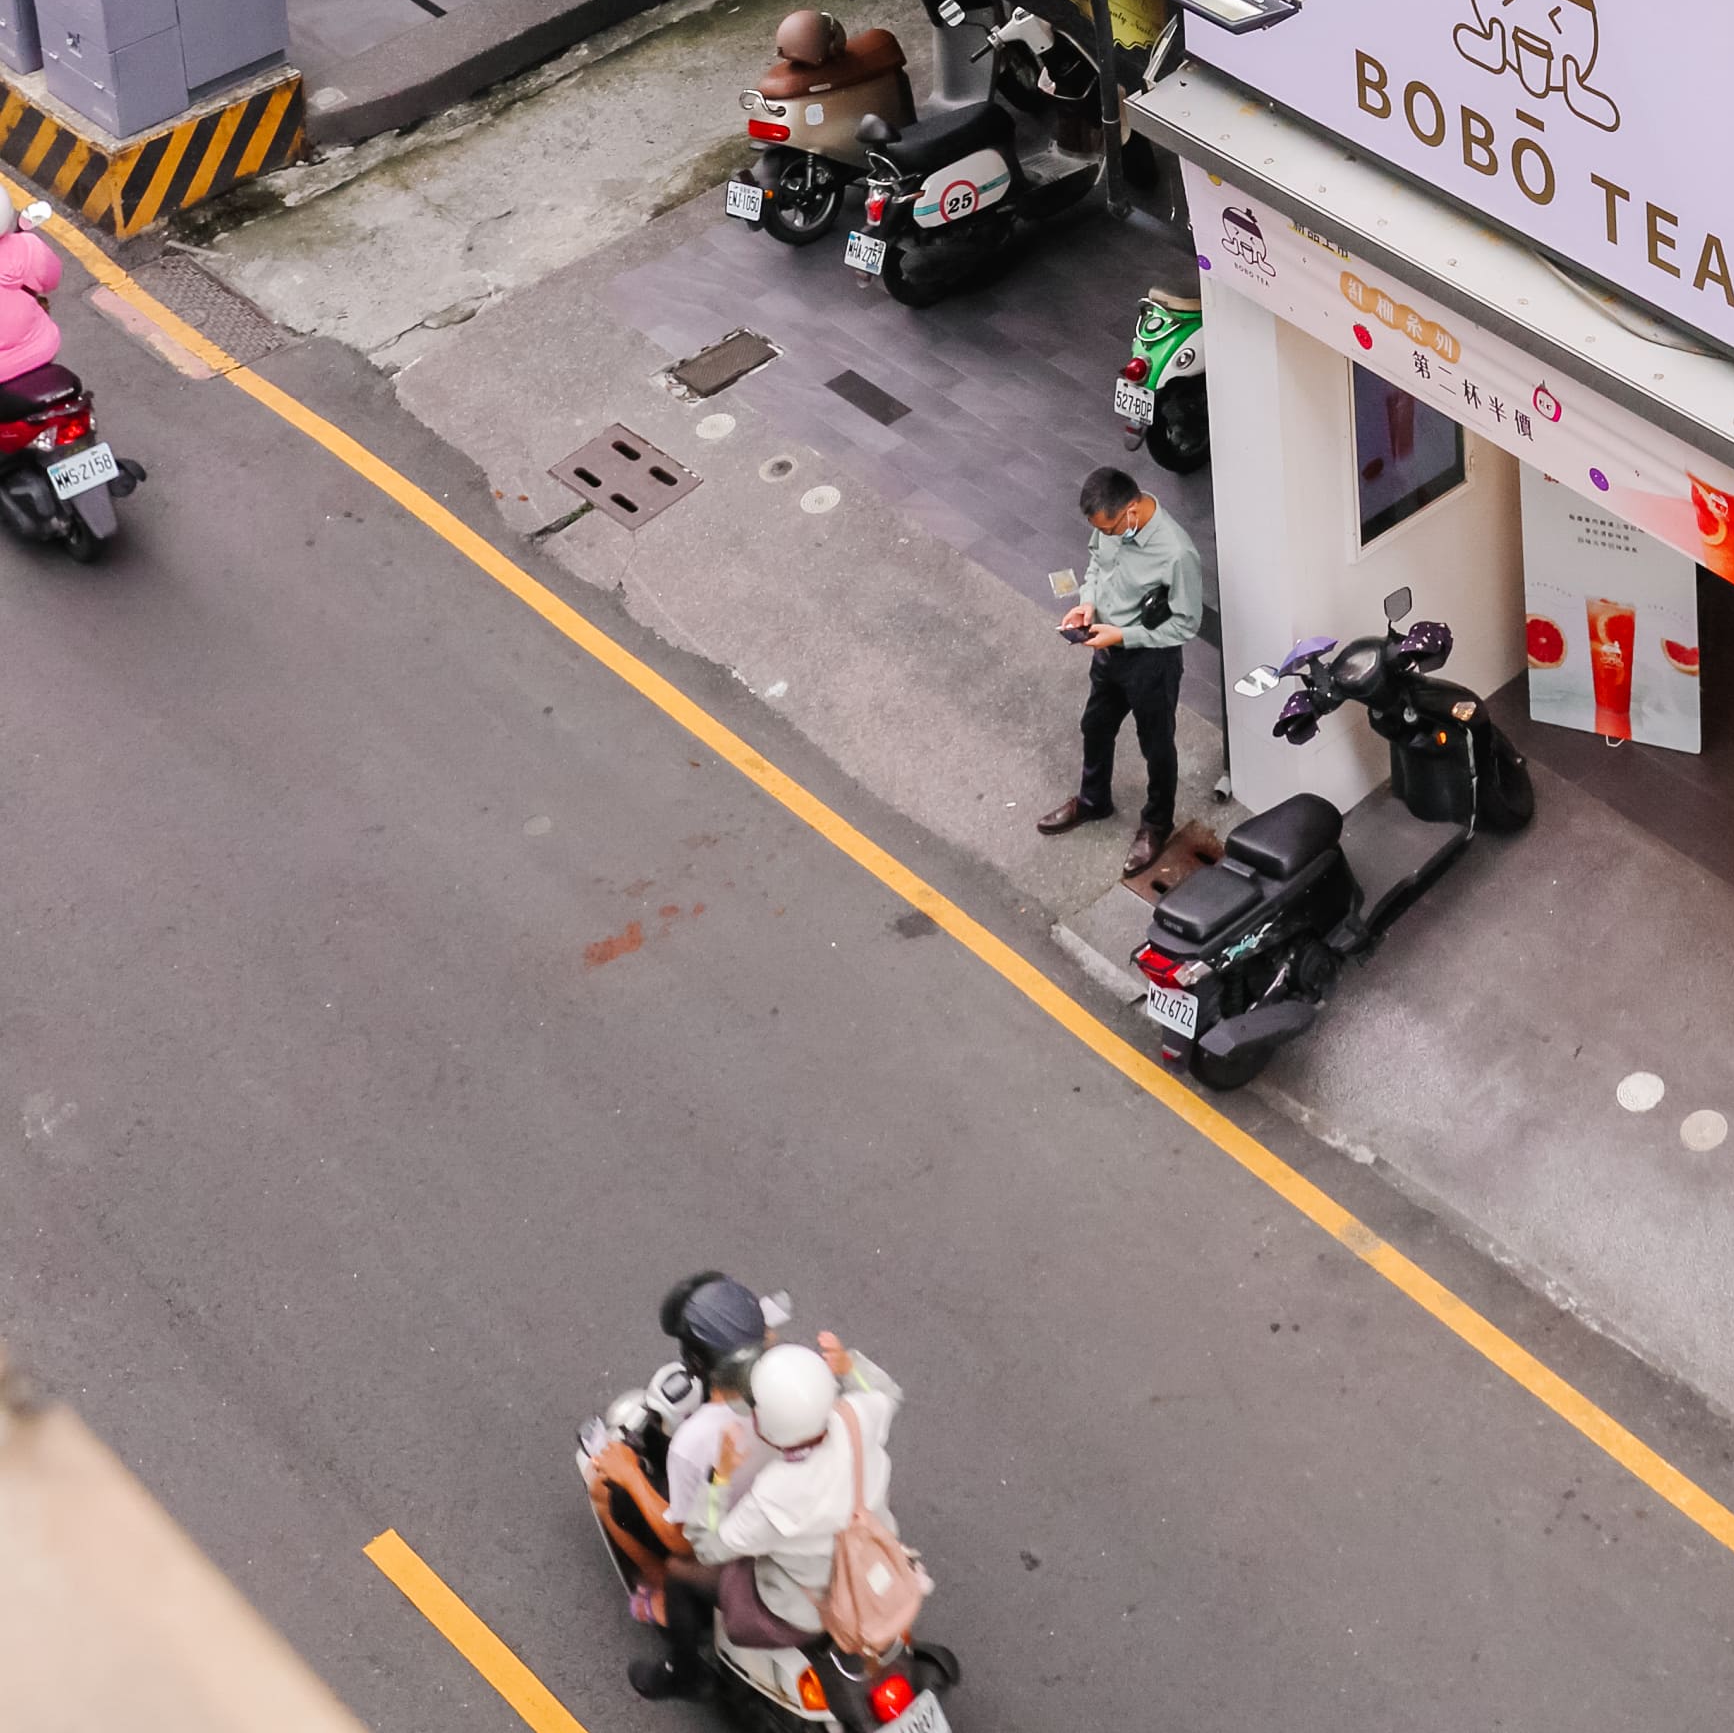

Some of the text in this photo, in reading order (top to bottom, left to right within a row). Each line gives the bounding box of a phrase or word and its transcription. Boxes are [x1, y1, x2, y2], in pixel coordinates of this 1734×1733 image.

[947, 192, 973, 215] 25
[1411, 349, 1535, 443] 第二杯半價
